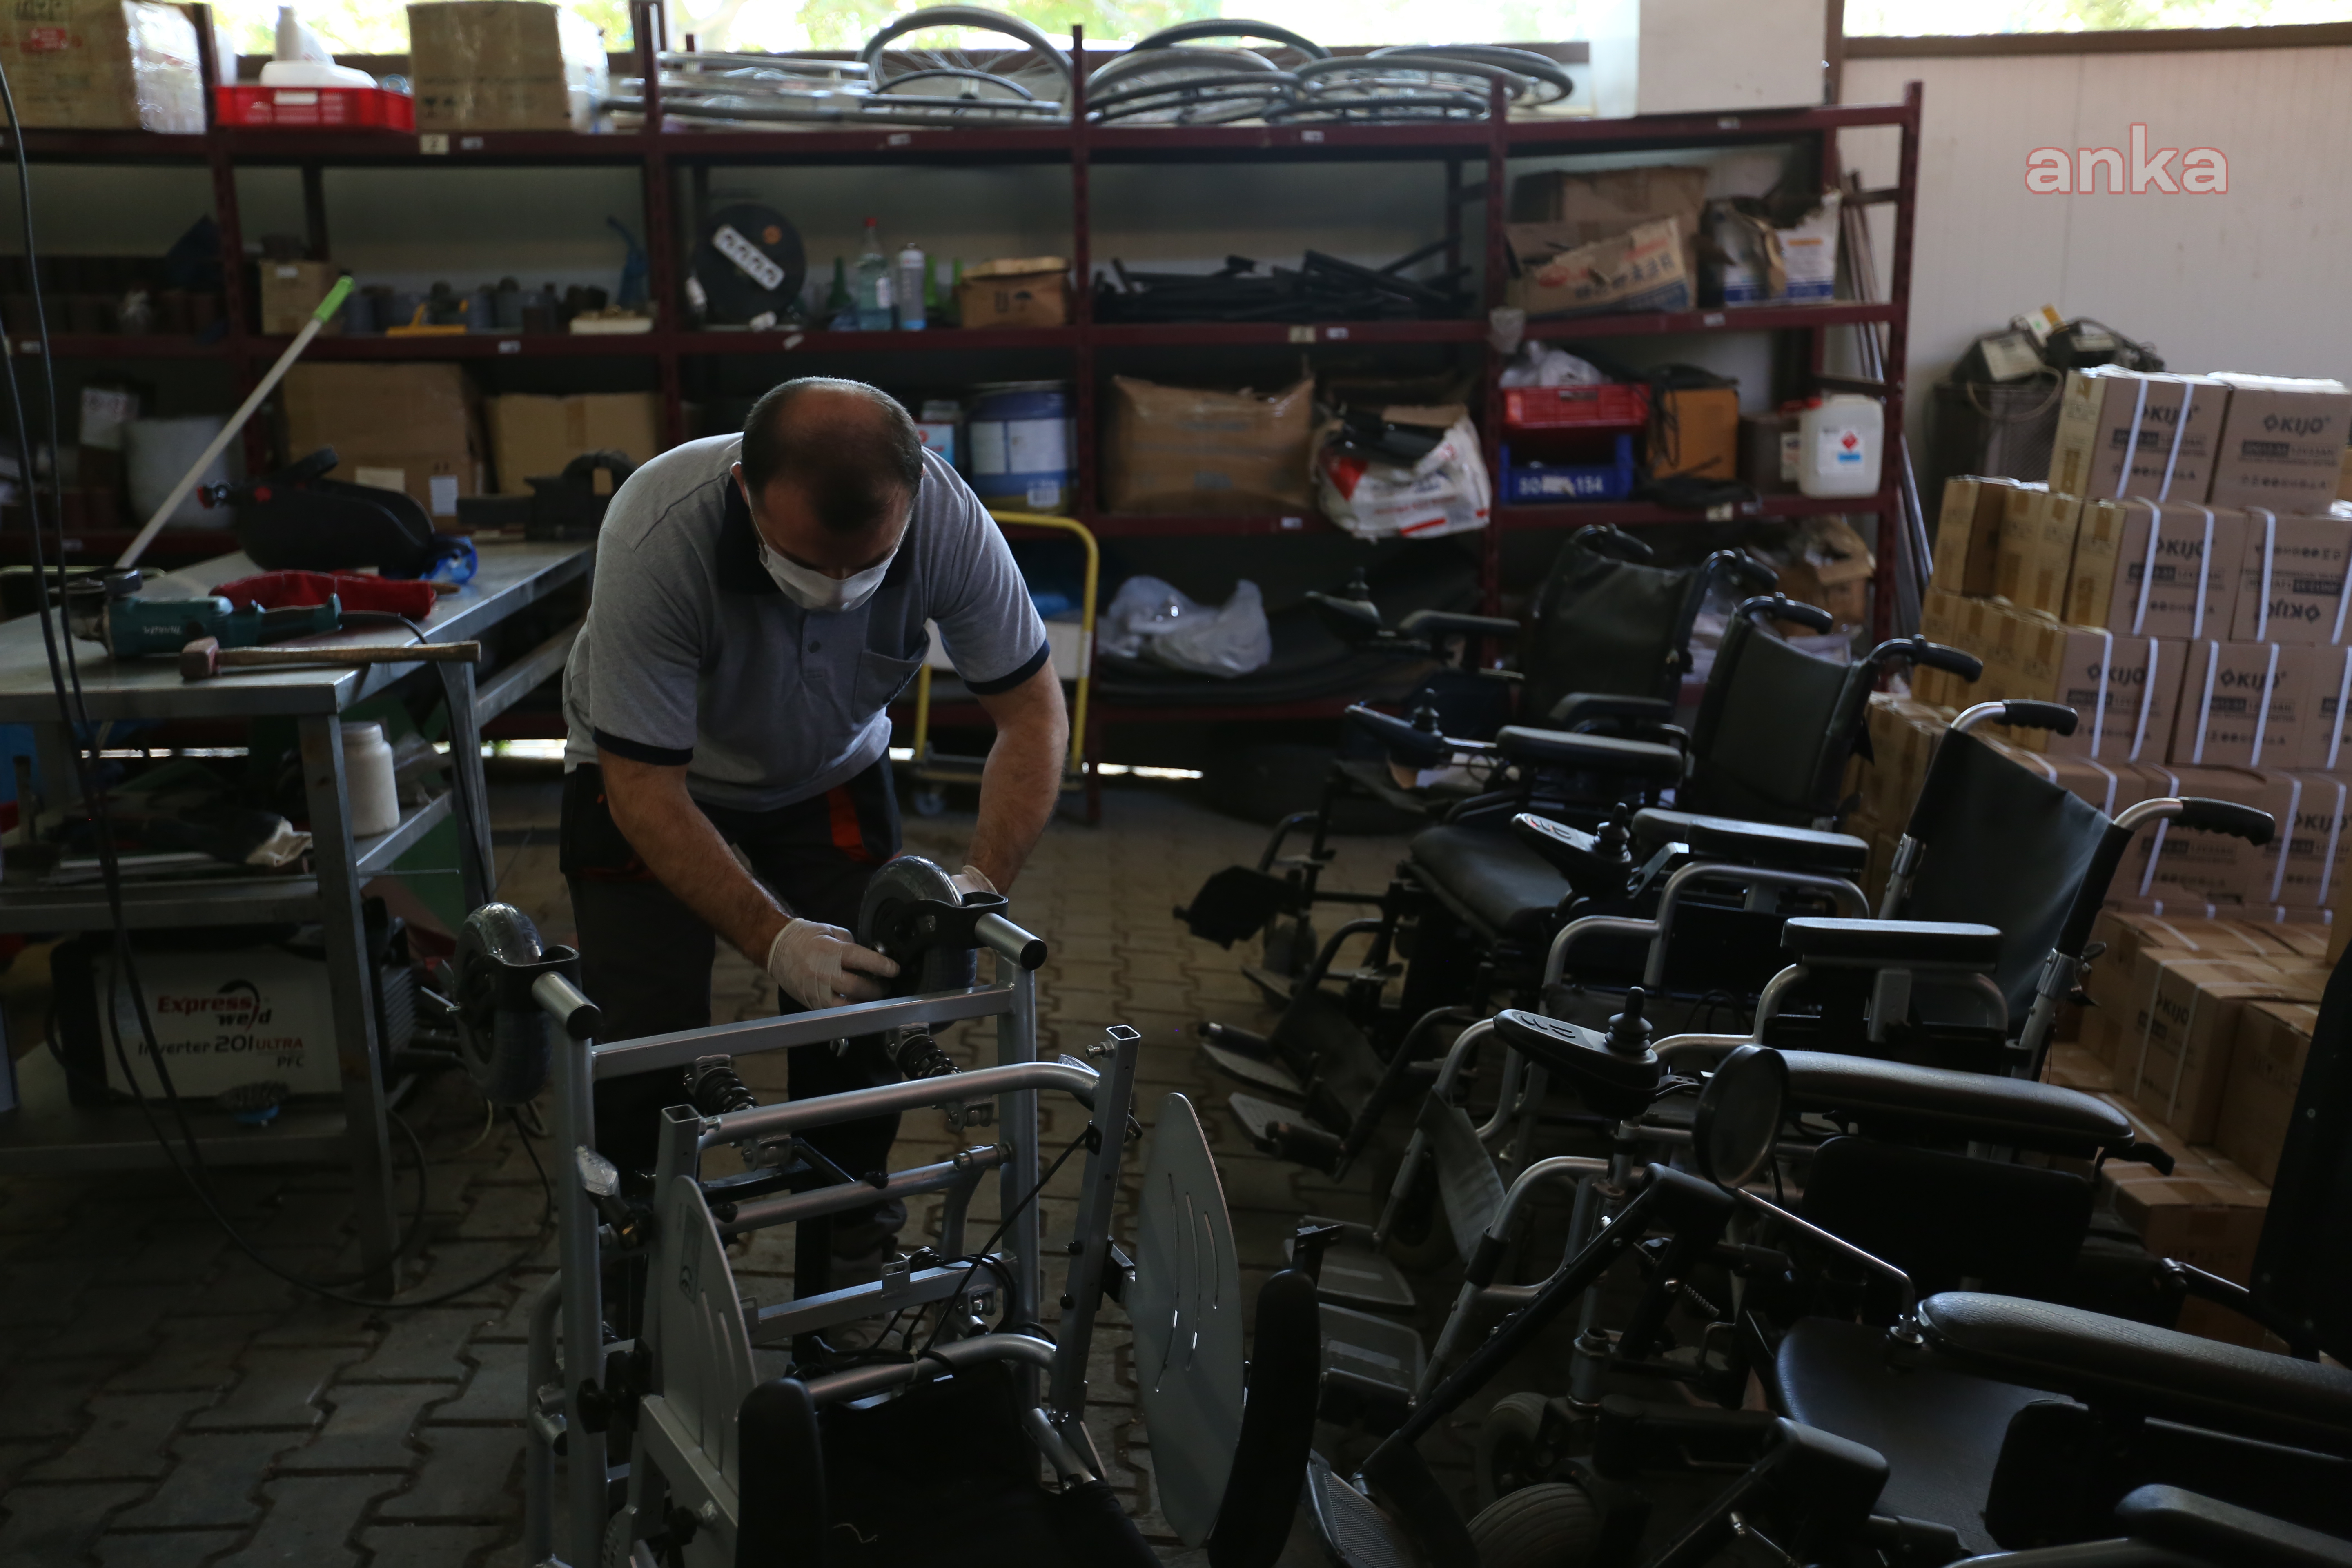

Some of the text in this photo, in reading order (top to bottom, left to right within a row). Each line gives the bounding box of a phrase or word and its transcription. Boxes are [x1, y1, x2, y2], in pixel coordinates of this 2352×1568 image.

[2280, 416, 2324, 437] KIJO
[157, 995, 253, 1016] Express
[2161, 996, 2190, 1026] KIJO
[216, 1002, 272, 1031] weld
[214, 1034, 254, 1053] 201
[256, 1037, 304, 1051] ULTRA
[277, 1055, 304, 1069] PFC
